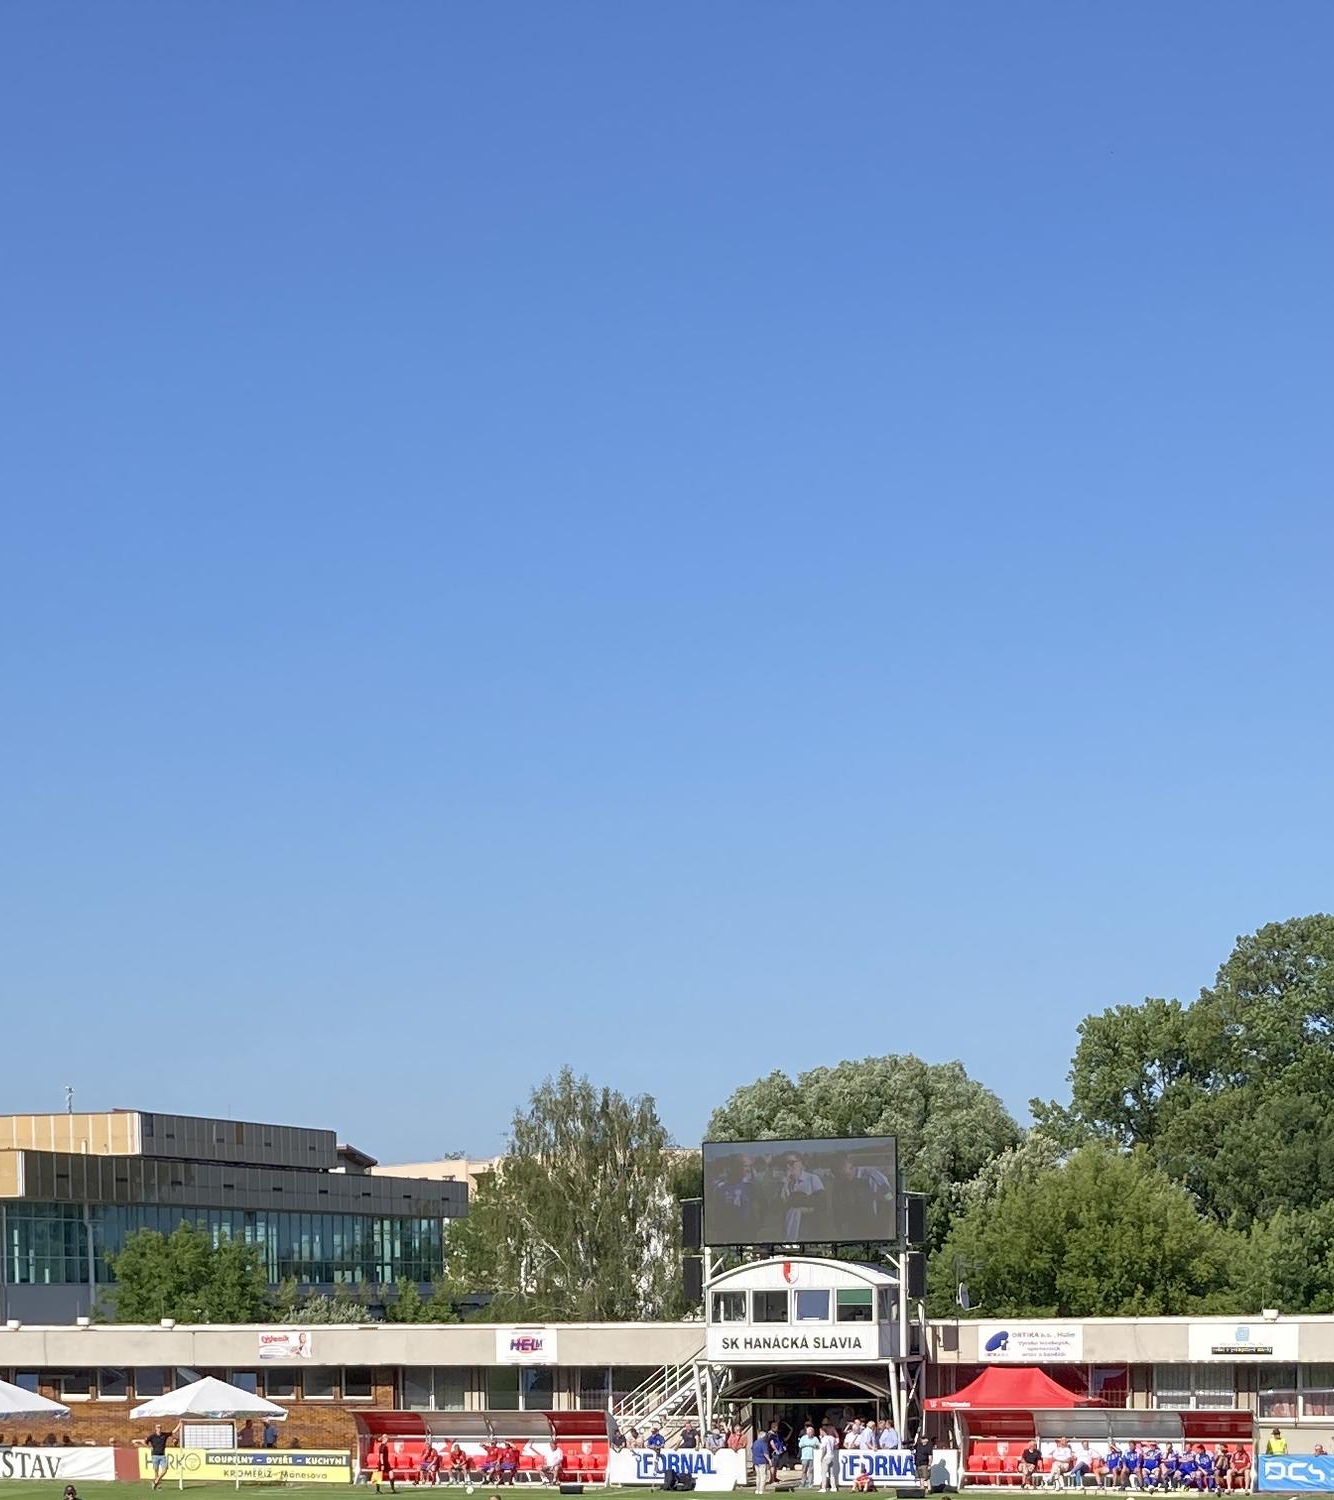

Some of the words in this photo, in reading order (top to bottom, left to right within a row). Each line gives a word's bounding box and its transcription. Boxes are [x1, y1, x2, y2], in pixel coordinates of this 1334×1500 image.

[722, 1337, 740, 1349] SK
[744, 1334, 809, 1349] HANÁCKÁ
[813, 1337, 862, 1349] SLAVIA
[208, 1455, 254, 1464] KOUPELNY
[305, 1455, 347, 1465] KUCHYNĚ
[642, 1453, 717, 1475] FORNAL
[848, 1455, 916, 1476] FORNA
